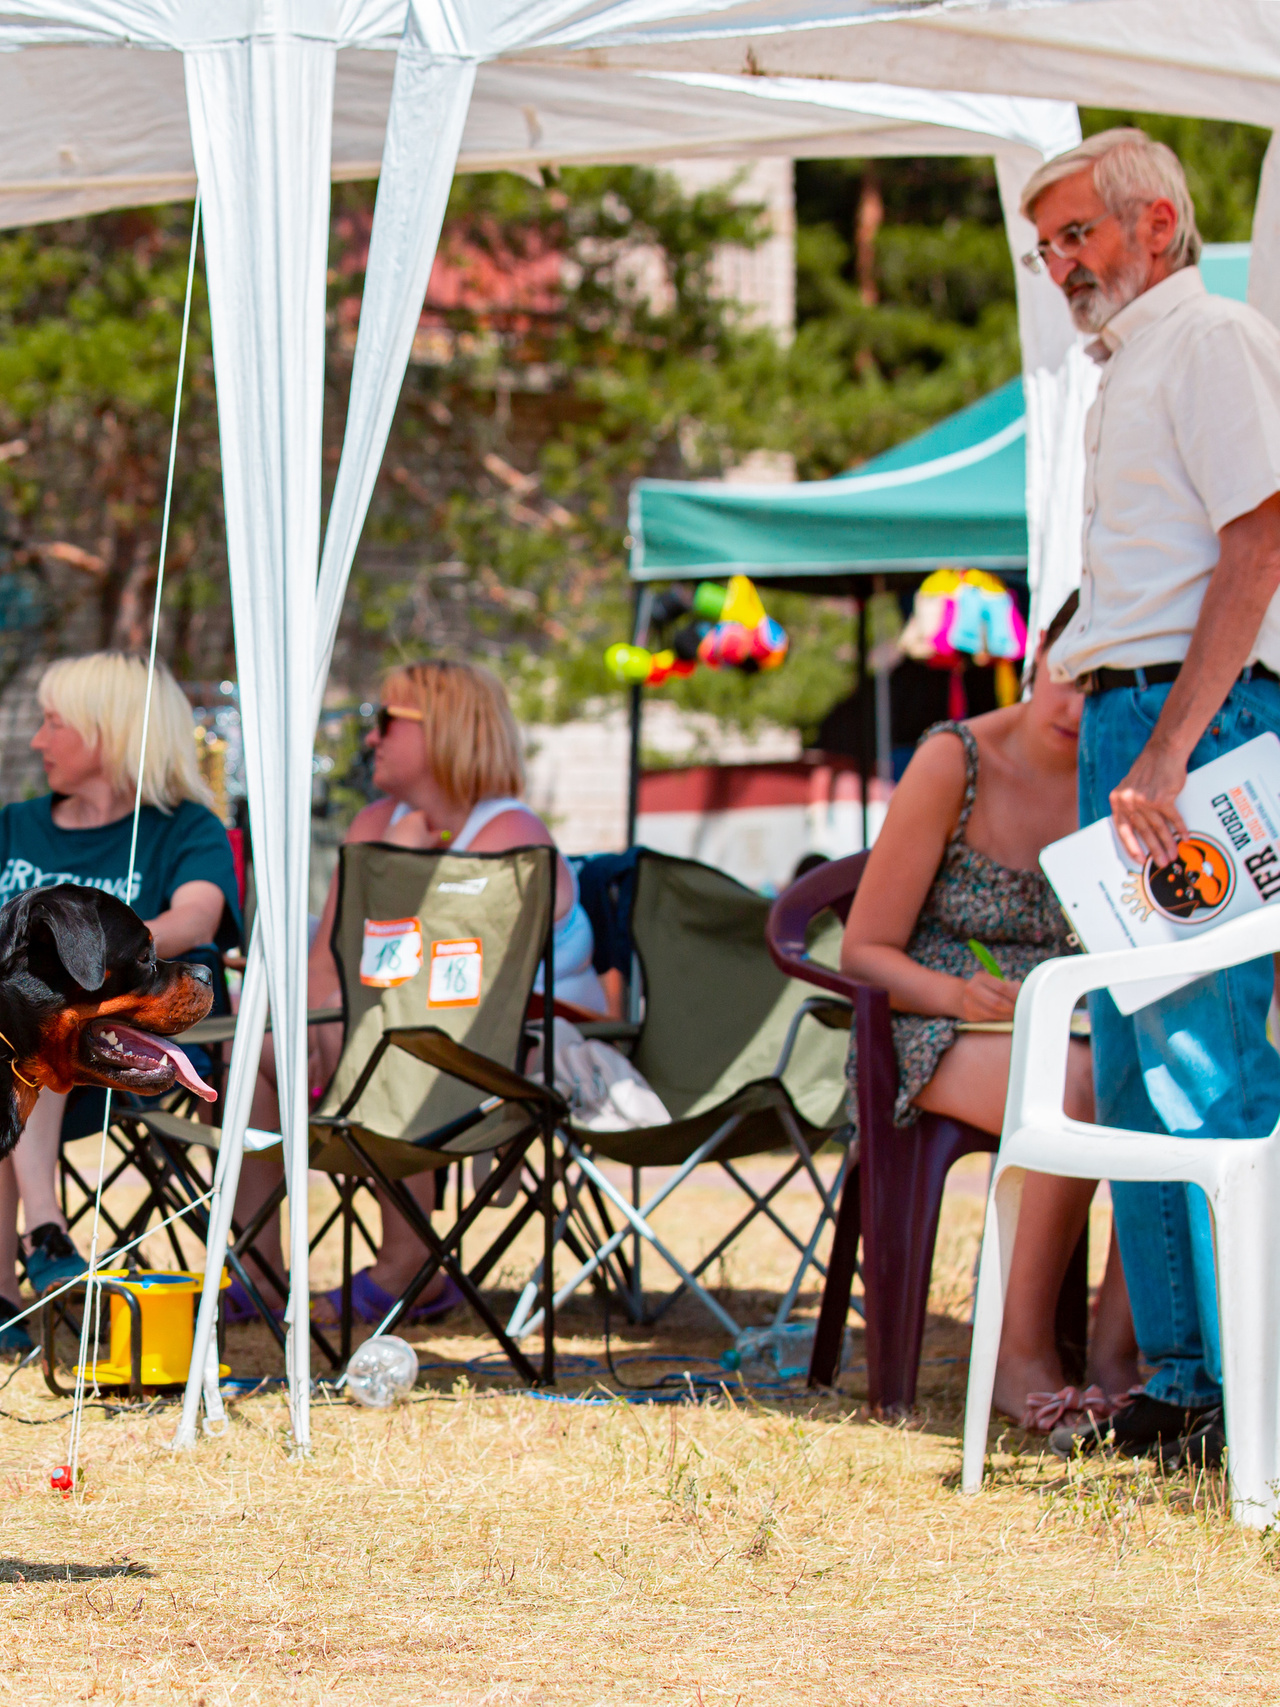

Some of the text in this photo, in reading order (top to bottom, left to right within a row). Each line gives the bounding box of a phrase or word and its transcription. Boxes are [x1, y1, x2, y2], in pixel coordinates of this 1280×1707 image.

[1211, 793, 1251, 851] WORLD
[375, 939, 402, 971] 18
[444, 957, 467, 993] 18
